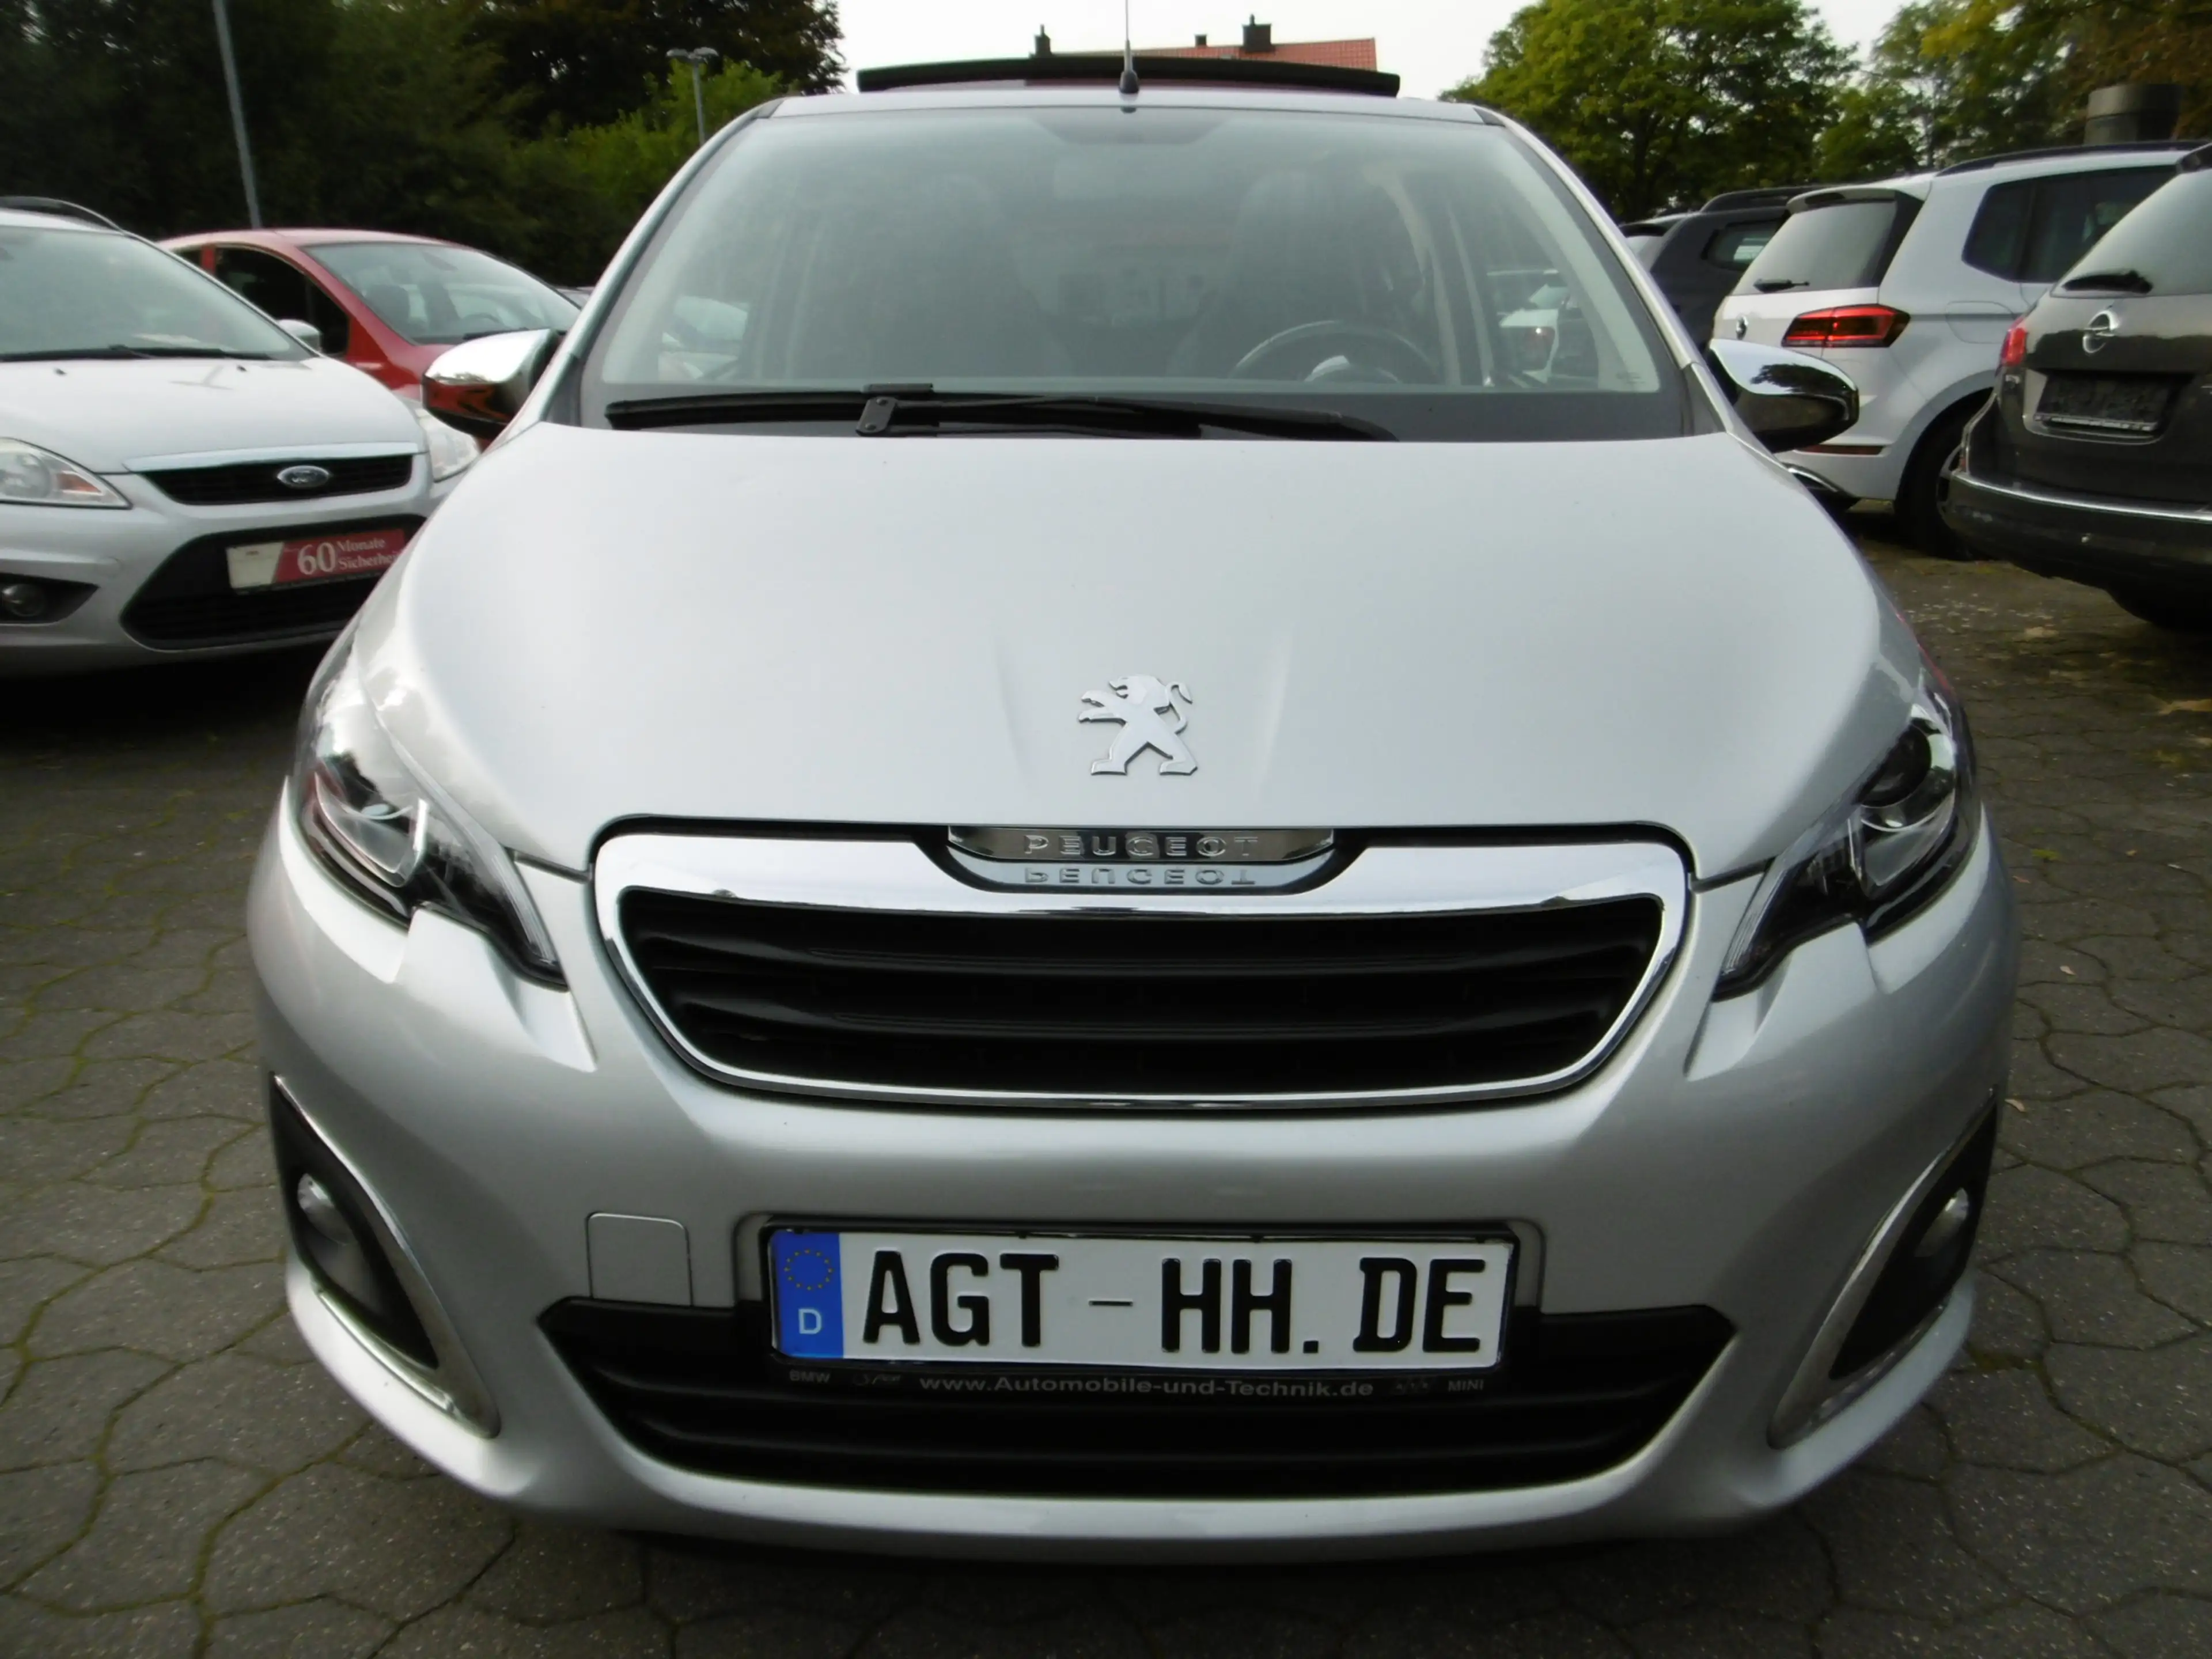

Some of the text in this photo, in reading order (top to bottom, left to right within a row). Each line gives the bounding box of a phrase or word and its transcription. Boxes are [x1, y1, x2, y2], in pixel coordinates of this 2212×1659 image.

[297, 542, 336, 575] 60
[336, 538, 386, 552] Monate
[1024, 835, 1259, 857] PEUGEOT
[863, 1249, 1059, 1347] AGT
[798, 1308, 823, 1335] D
[789, 1369, 831, 1384] BMW
[919, 1376, 1374, 1396] www.Automobile-und-Technik.de
[1448, 1379, 1484, 1392] MINI
